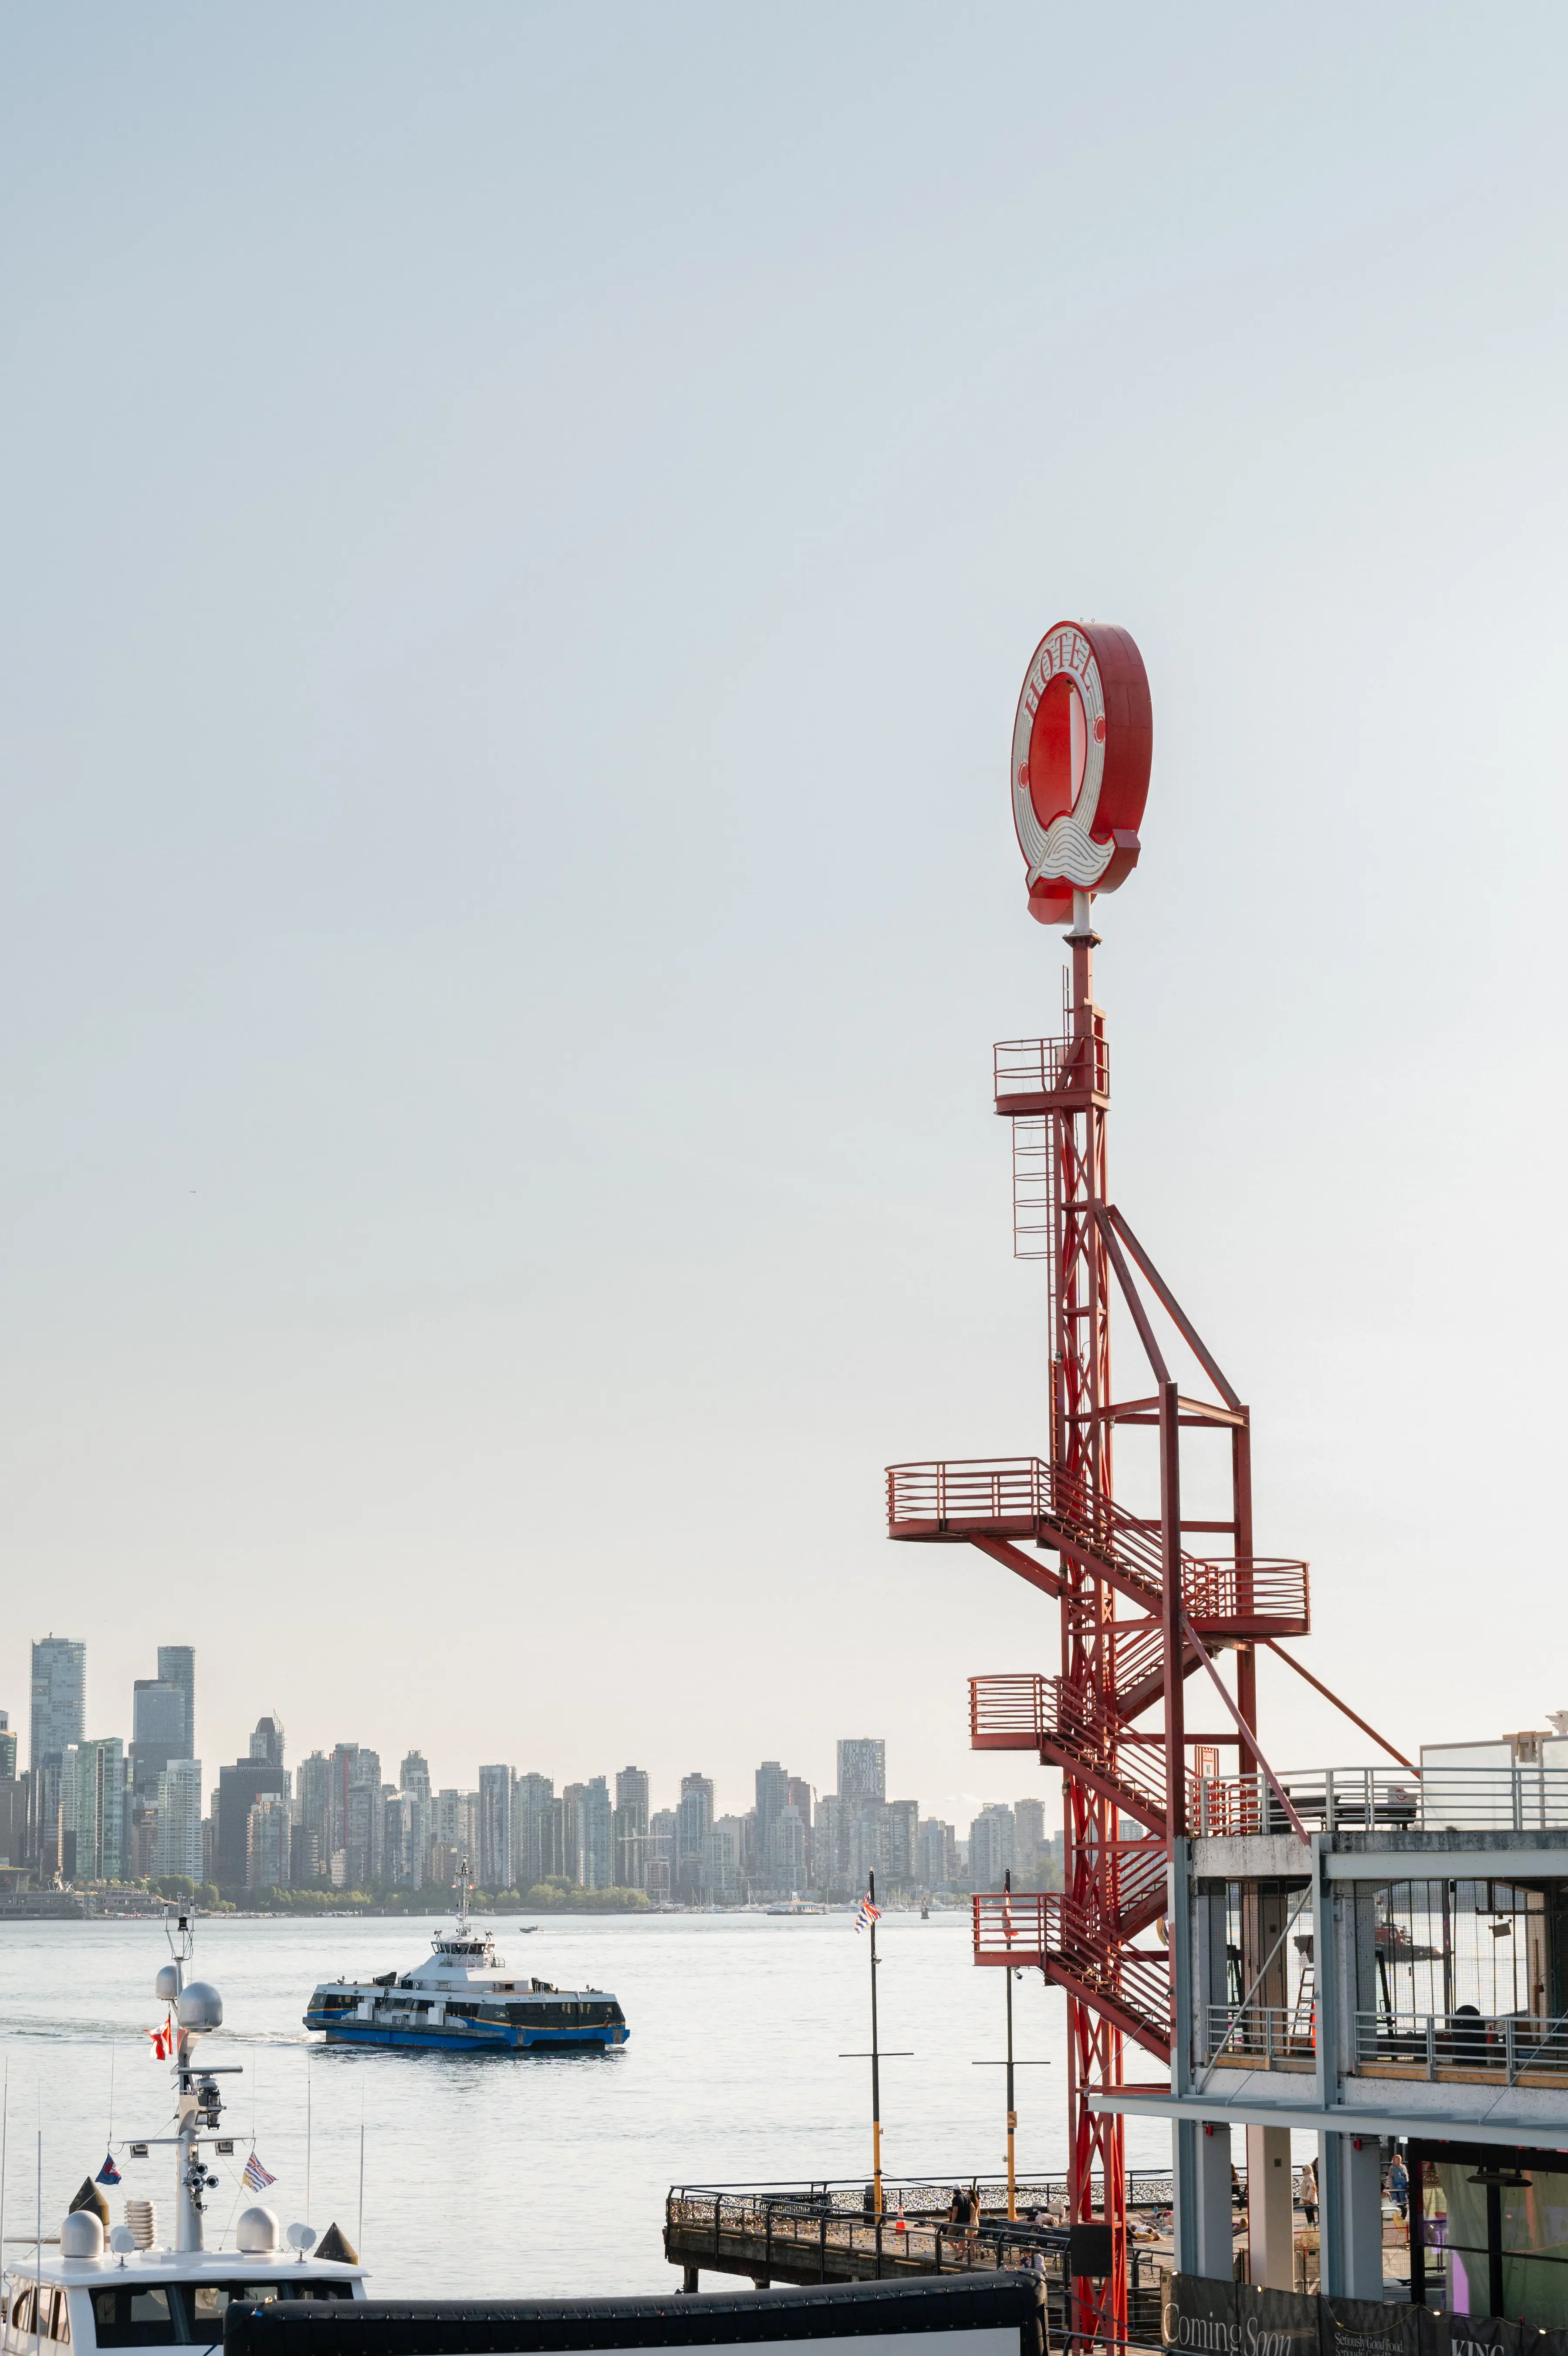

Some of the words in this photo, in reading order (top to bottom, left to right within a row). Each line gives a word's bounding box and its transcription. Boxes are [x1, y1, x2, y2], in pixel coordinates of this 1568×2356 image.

[1025, 633, 1094, 719] HOTEL
[1164, 2303, 1241, 2356] Coming
[1244, 2317, 1291, 2356] Soon
[1335, 2332, 1365, 2350] Seriously
[1366, 2336, 1386, 2350] Good
[1386, 2339, 1404, 2353] Food.
